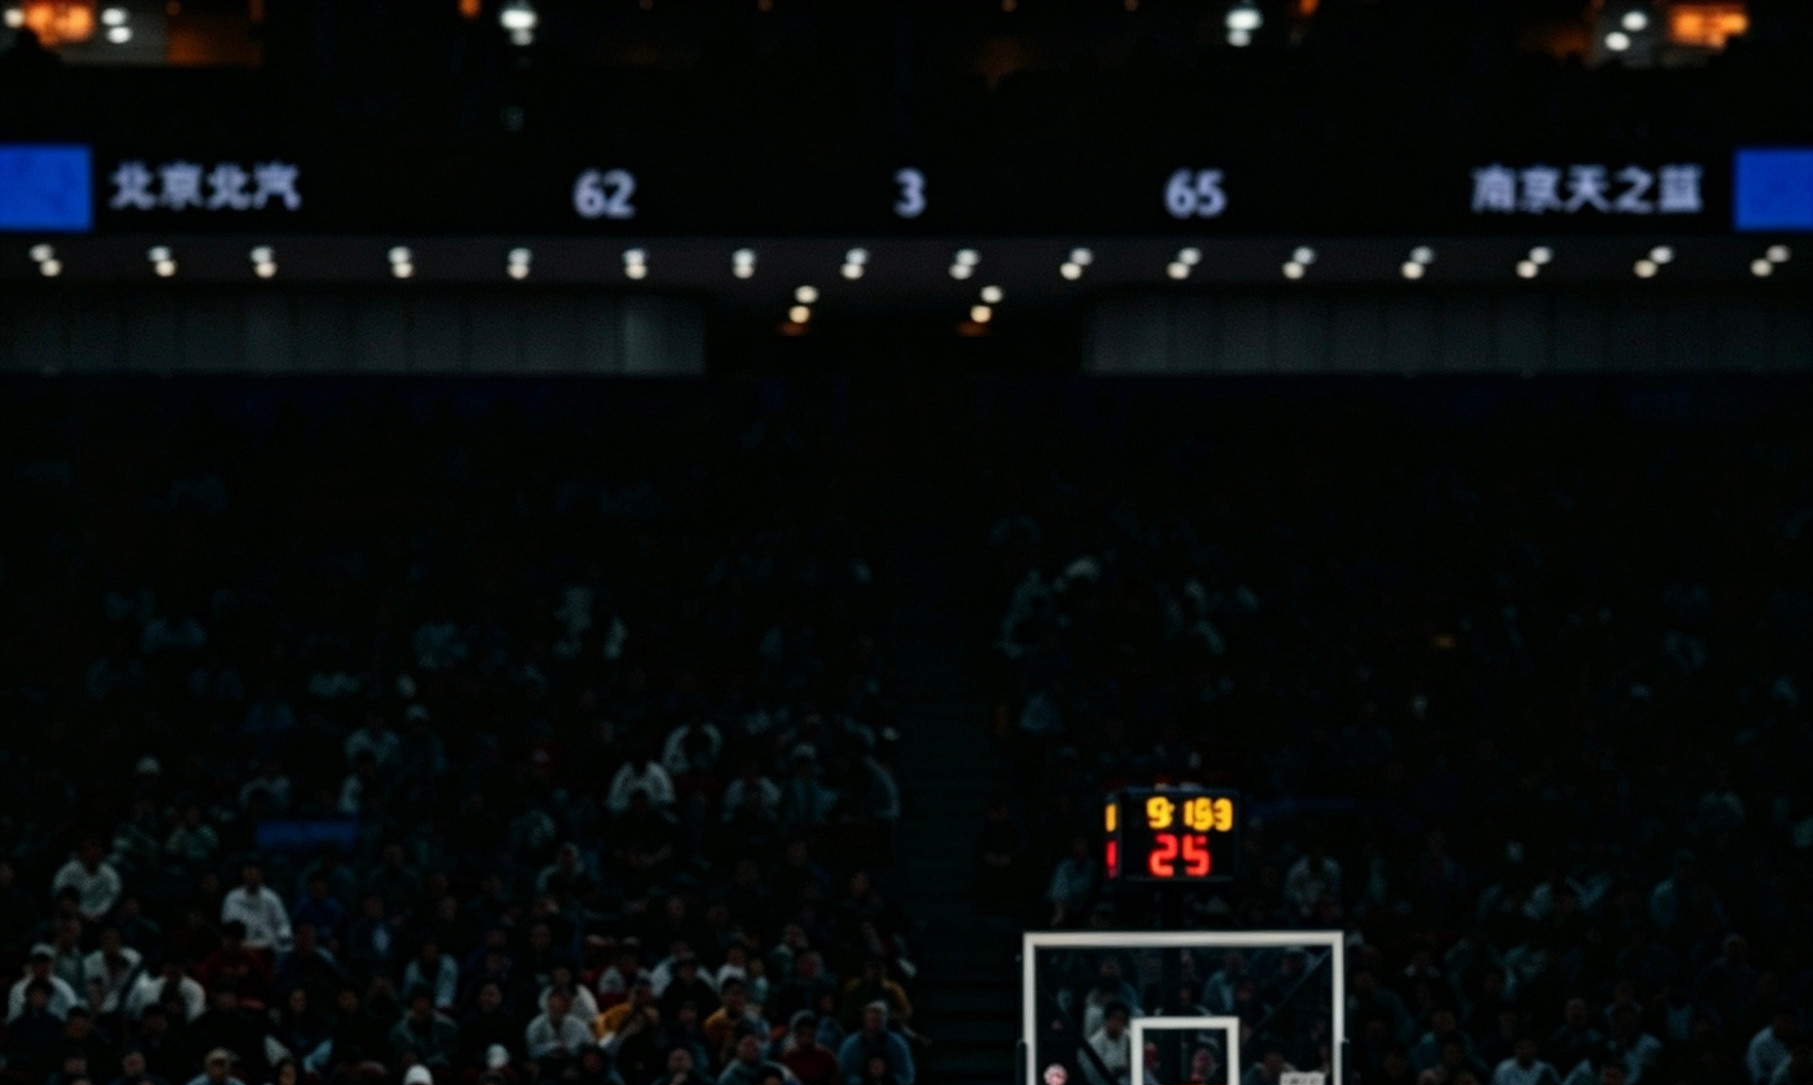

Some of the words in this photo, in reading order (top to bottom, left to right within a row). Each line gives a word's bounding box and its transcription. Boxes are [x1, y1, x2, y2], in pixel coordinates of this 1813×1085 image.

[110, 160, 302, 211] 北京北汽
[574, 168, 636, 219] 62
[895, 168, 926, 218] 3
[1165, 168, 1227, 218] 65
